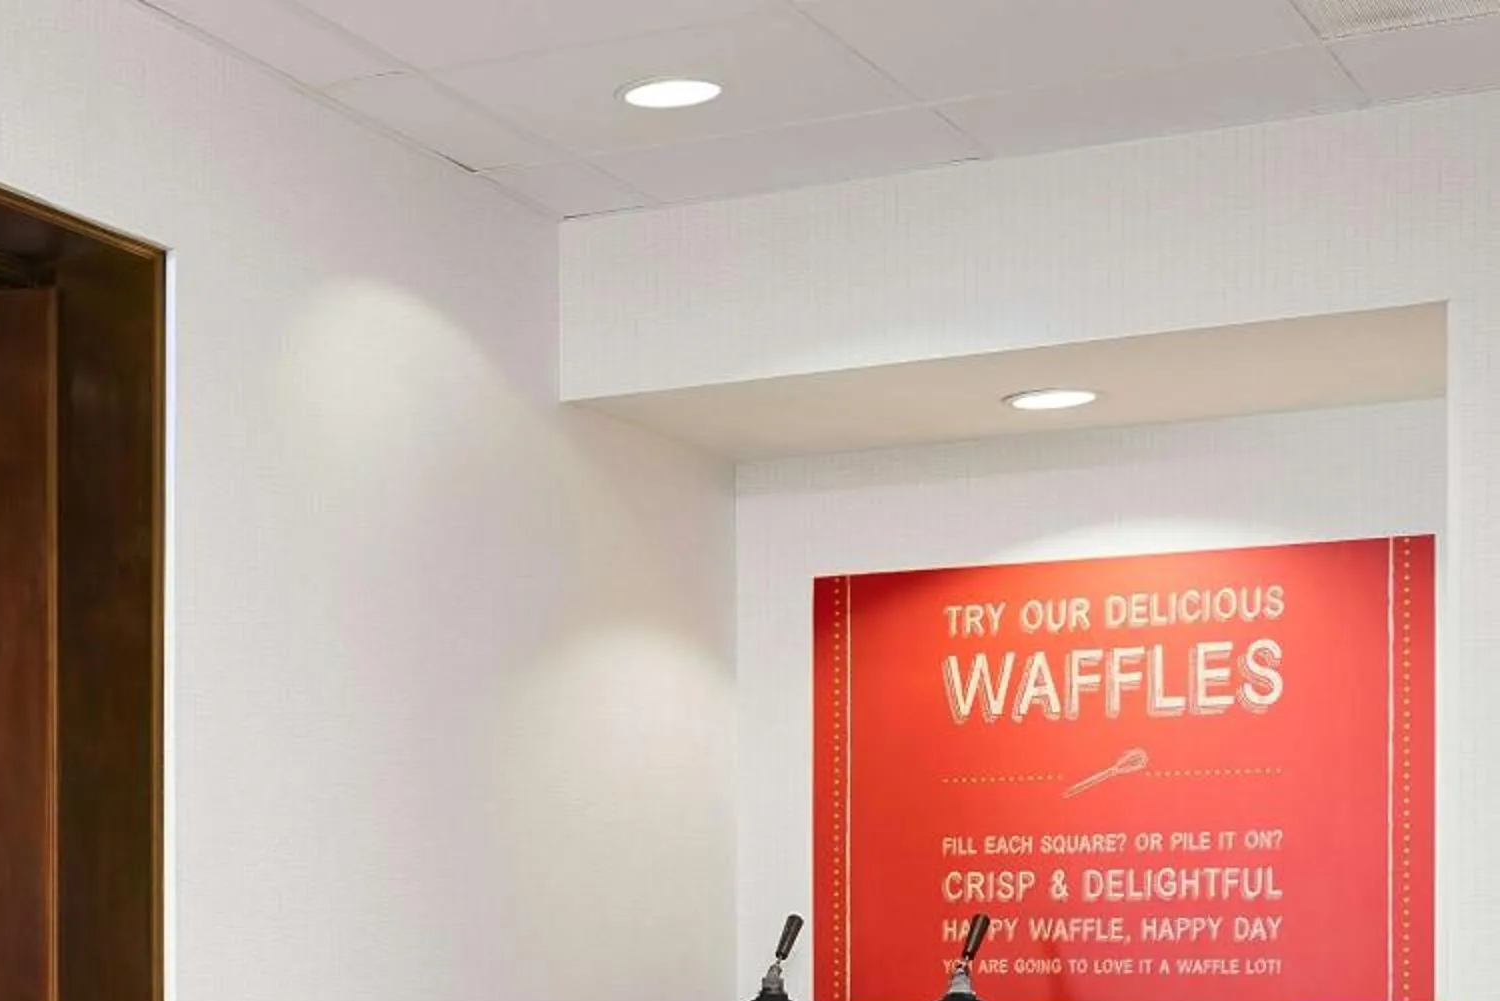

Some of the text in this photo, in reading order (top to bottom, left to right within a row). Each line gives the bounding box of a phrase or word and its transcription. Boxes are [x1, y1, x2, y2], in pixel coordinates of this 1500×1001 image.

[944, 585, 1284, 639] TRY OUR DELICIOUS
[942, 638, 1284, 724] WAFFLES
[942, 829, 1283, 857] FILL EACH SQUARE? OR PILE IT ON?
[942, 866, 1283, 902] CRISP & DELIGHTFUL
[942, 916, 1283, 945] HAPY WAFFLE, HAPPY DAY
[978, 959, 1009, 974] ARE
[1014, 959, 1062, 974] GOING
[1067, 959, 1088, 974] TO
[1093, 959, 1133, 974] LOVE
[1138, 959, 1152, 974] IT
[1158, 959, 1170, 974] A
[1176, 959, 1240, 974] WAFFLE
[1245, 959, 1282, 974] LOT!
